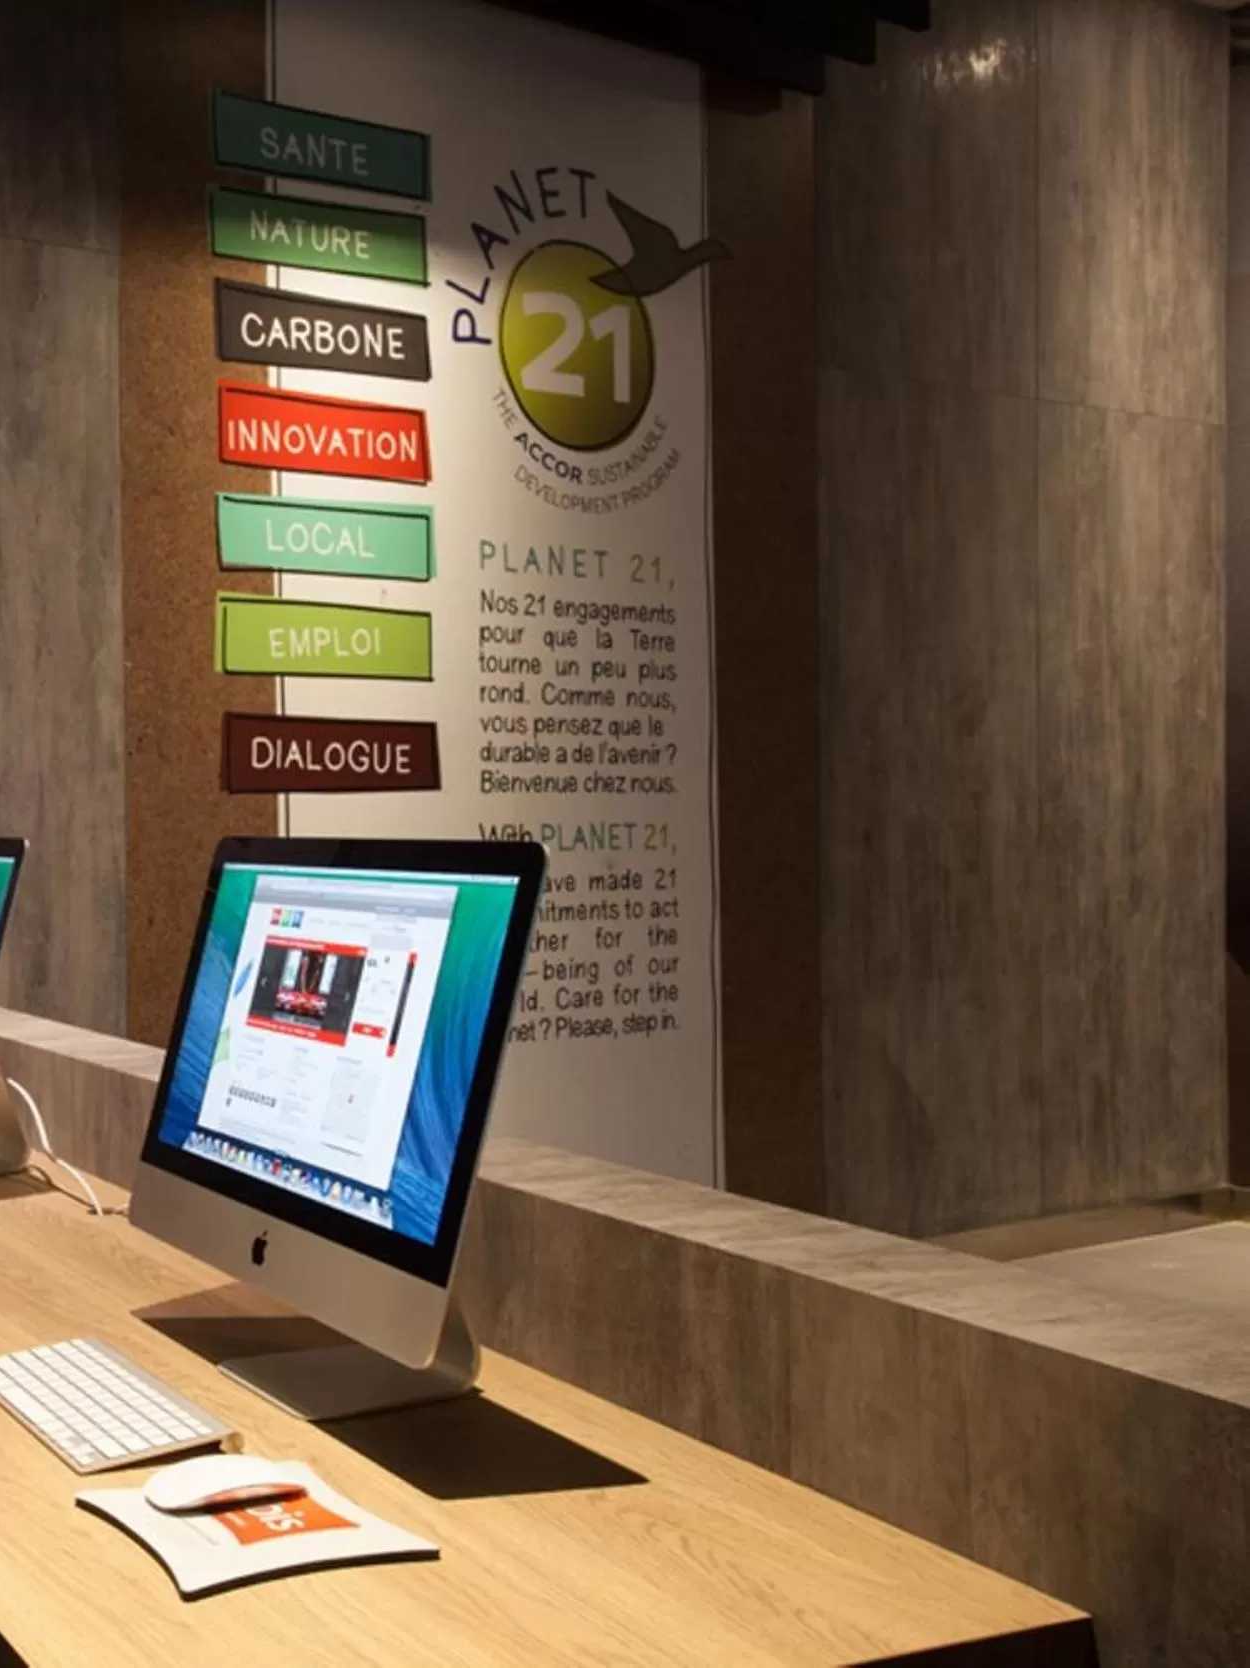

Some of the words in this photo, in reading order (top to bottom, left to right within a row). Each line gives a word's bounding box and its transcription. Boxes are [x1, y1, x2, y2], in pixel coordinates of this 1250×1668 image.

[259, 126, 370, 178] SANTE
[249, 208, 371, 260] NATURE
[444, 166, 597, 345] PLANET
[240, 312, 406, 360] CARBONE
[520, 291, 631, 404] 21
[226, 418, 418, 464] INNOVATION
[513, 432, 584, 485] ACCOR
[264, 518, 376, 559] LOCAL
[479, 540, 608, 579] PLANET
[630, 553, 676, 592] 21,
[480, 588, 519, 616] Nos
[523, 593, 546, 617] 21
[553, 599, 677, 626] engagements
[268, 626, 382, 659] EMPLOI
[479, 625, 525, 647] pour
[543, 629, 579, 652] que
[596, 628, 614, 650] la
[630, 628, 676, 653] Terre
[479, 652, 542, 675] tourne
[556, 658, 580, 678] un
[591, 660, 627, 684] peu
[639, 660, 678, 685] plus
[480, 682, 530, 705] rond.
[541, 682, 616, 707] Comme
[626, 691, 677, 714] nous,
[480, 715, 528, 735] vous
[533, 716, 604, 742] pensez
[608, 718, 643, 741] que
[648, 714, 665, 737] le
[250, 735, 412, 774] DIALOGUE
[480, 740, 551, 765] durable
[555, 746, 568, 765] a
[572, 741, 594, 765] de
[598, 740, 662, 766] l'avenir
[480, 769, 579, 795] Bienvenue
[583, 770, 628, 794] chez
[541, 821, 638, 852] PLANET
[644, 823, 678, 857] 21,
[544, 873, 576, 893] ave
[588, 868, 643, 893] made
[654, 867, 678, 891] 21
[538, 897, 620, 923] itments
[625, 897, 645, 922] to
[649, 897, 680, 921] act
[595, 926, 624, 950] for
[647, 924, 679, 947] the
[614, 952, 636, 978] of
[648, 956, 680, 976] our
[555, 985, 605, 1012] Care
[613, 982, 641, 1007] for
[648, 979, 680, 1004] the
[555, 1015, 619, 1041] Please,
[622, 1011, 659, 1038] step
